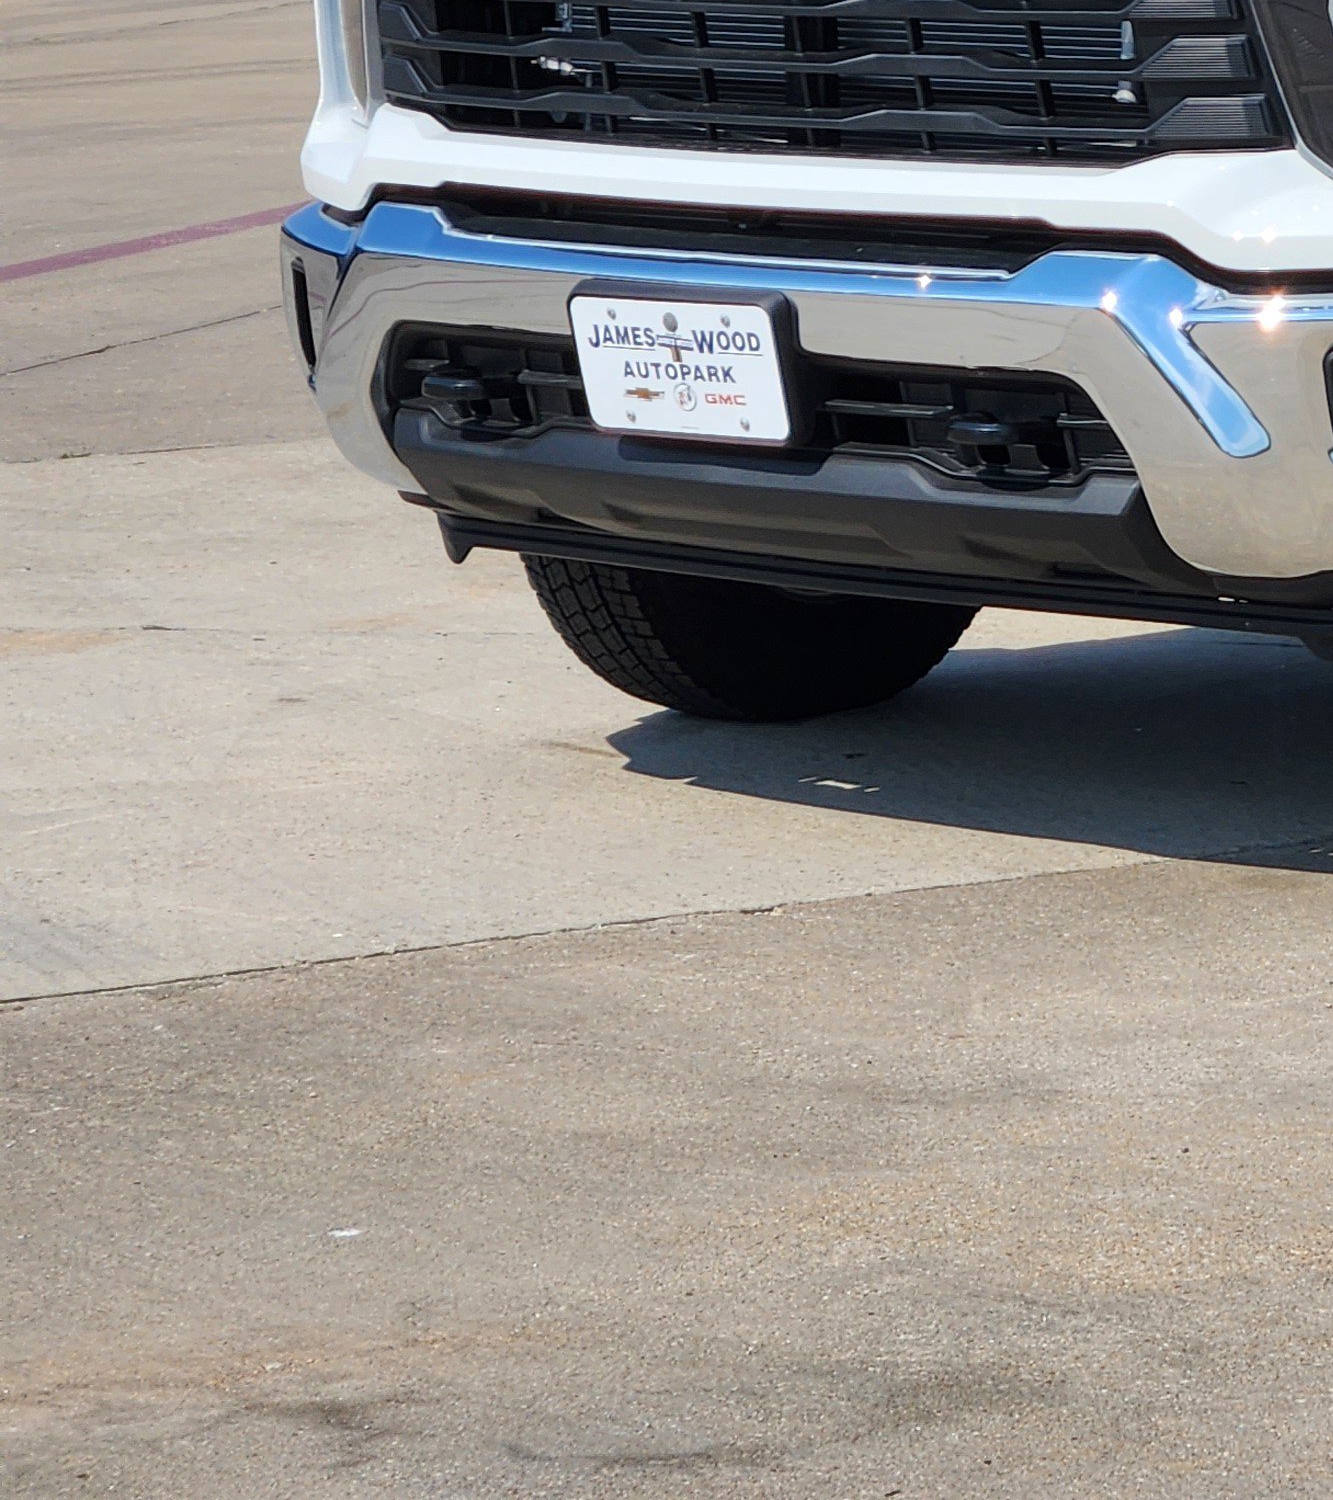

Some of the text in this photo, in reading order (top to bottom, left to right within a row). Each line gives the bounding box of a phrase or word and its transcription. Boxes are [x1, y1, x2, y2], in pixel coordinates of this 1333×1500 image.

[588, 323, 761, 354] JAMES WOOD
[623, 360, 737, 383] AUTOPARK
[704, 392, 747, 406] GMC
